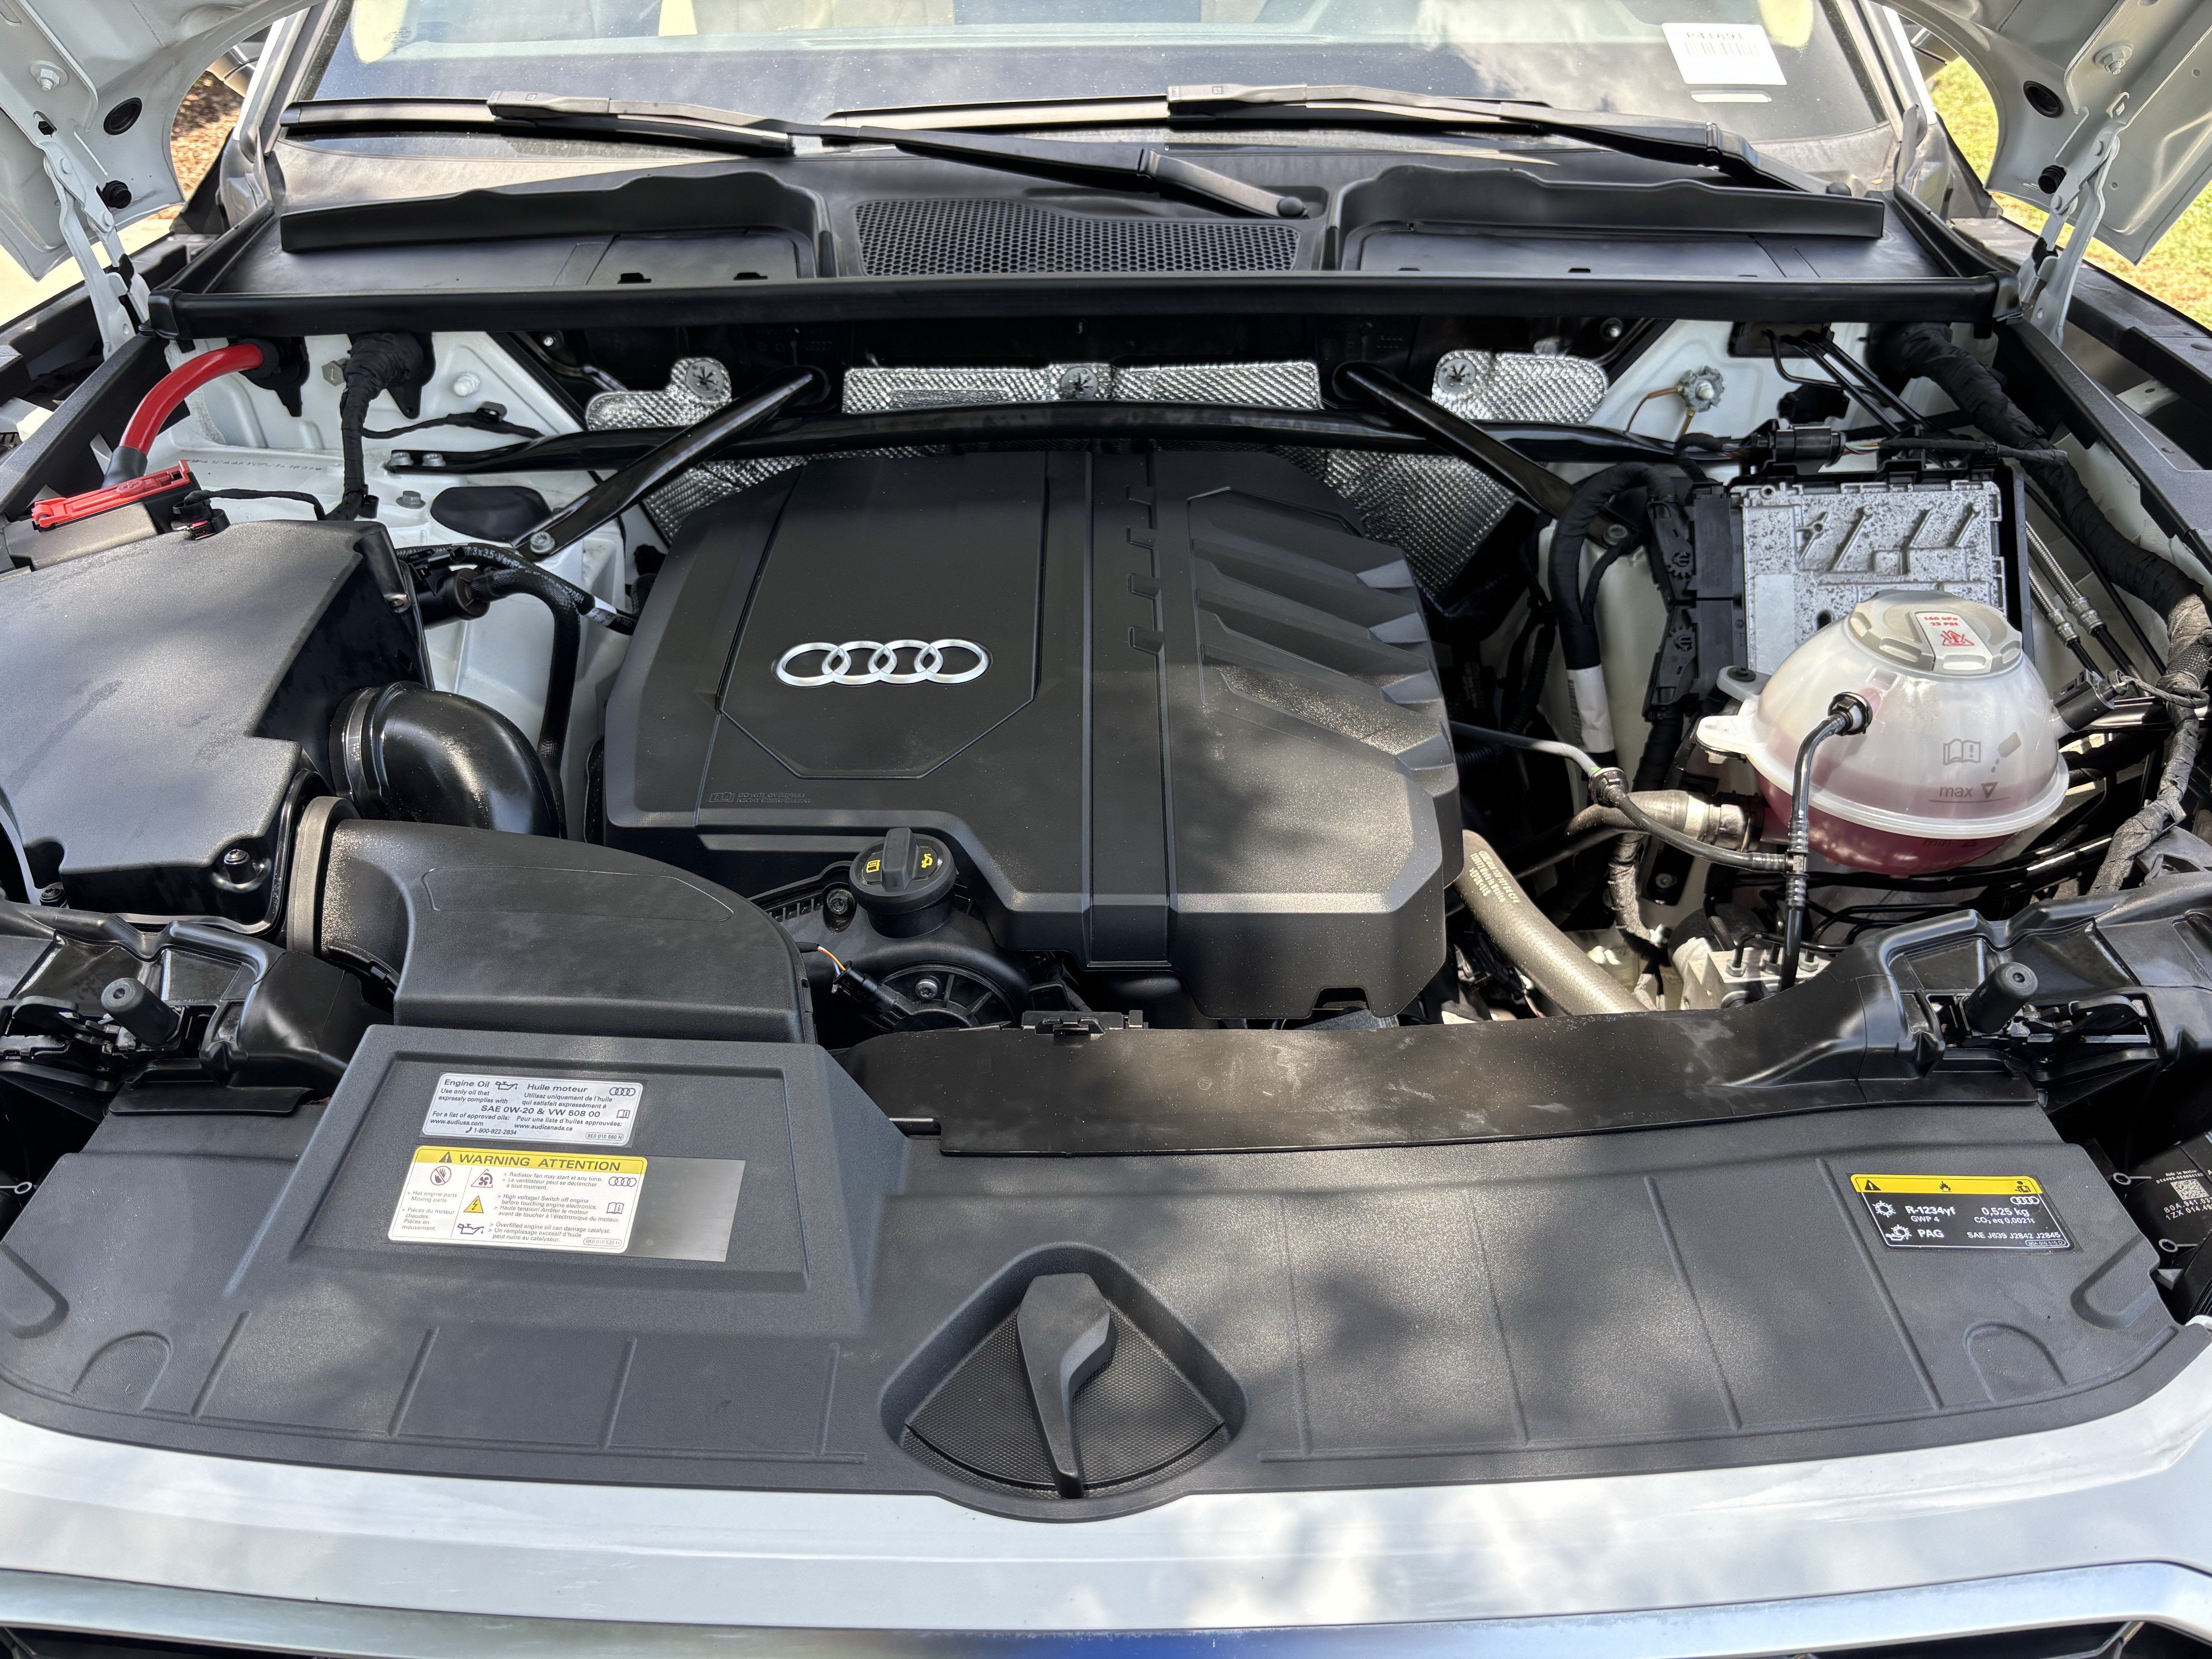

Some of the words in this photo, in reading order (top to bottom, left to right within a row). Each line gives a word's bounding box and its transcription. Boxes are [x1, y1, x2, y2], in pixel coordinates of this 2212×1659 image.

[1939, 785, 1973, 798] max
[443, 1079, 475, 1087] Engine
[503, 1106, 534, 1114] 0W-20
[459, 1154, 531, 1166] WARNING
[537, 1158, 621, 1171] ATTENTION
[1904, 1205, 1956, 1216] R-1234yf
[1981, 1207, 2013, 1216] 0,525
[2013, 1207, 2030, 1217] kg
[2166, 1209, 2185, 1221] 1ZX
[2185, 1203, 2212, 1214] 014.49
[1917, 1229, 1944, 1238] PAG
[2035, 1231, 2062, 1240] J2845
